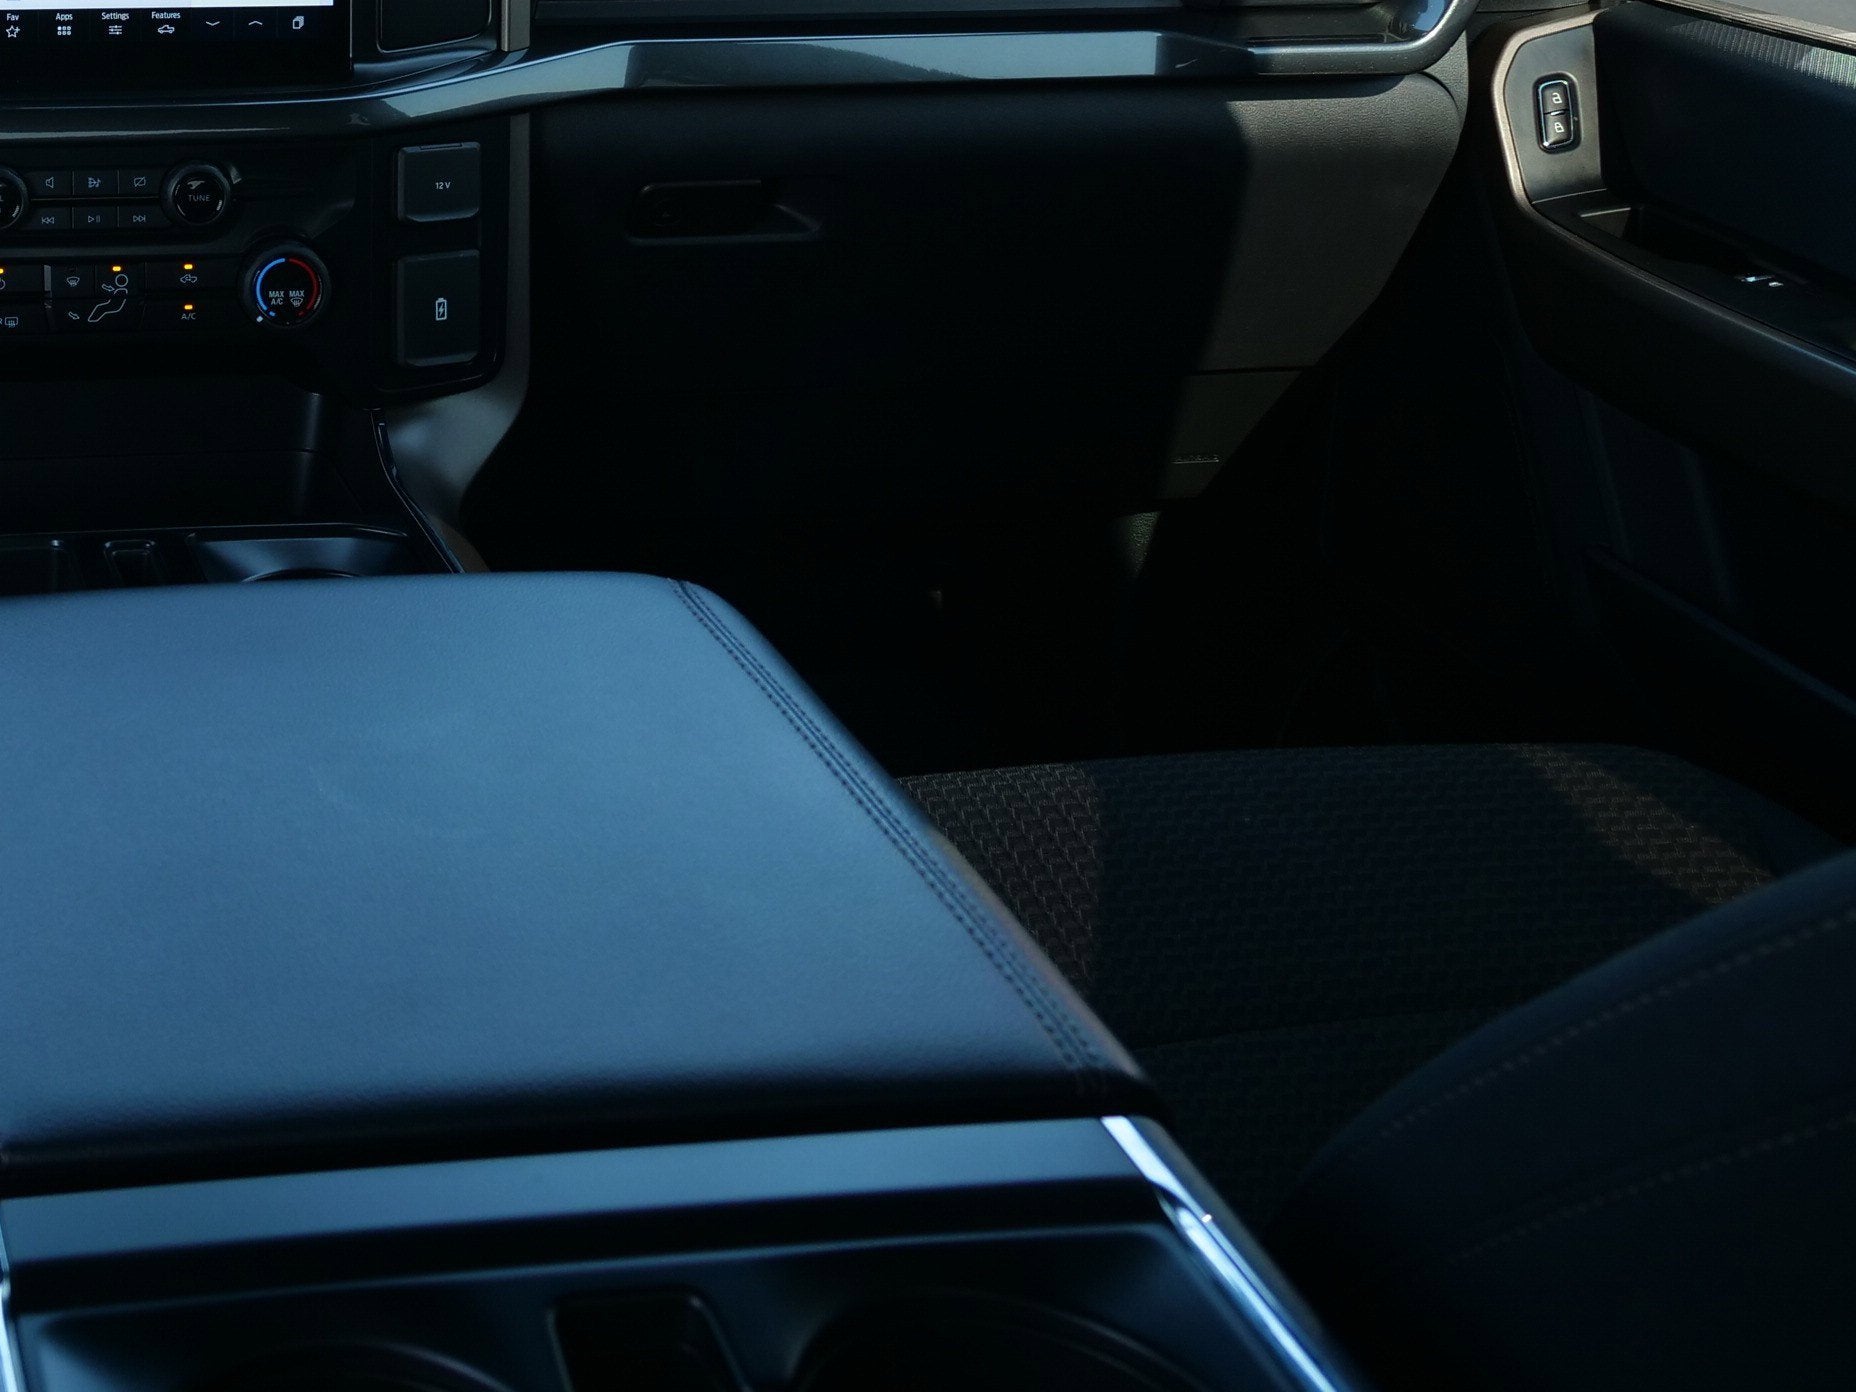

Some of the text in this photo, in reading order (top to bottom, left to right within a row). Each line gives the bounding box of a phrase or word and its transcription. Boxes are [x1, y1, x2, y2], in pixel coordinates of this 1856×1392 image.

[6, 13, 19, 21] Fav
[55, 12, 73, 22] Apps
[101, 11, 129, 22] Settings
[151, 11, 181, 19] Features
[434, 181, 452, 190] 12V
[187, 193, 211, 202] TUNE
[269, 290, 285, 299] MAX
[289, 289, 305, 298] MAX
[271, 297, 284, 306] A/C
[180, 311, 198, 321] A/C
